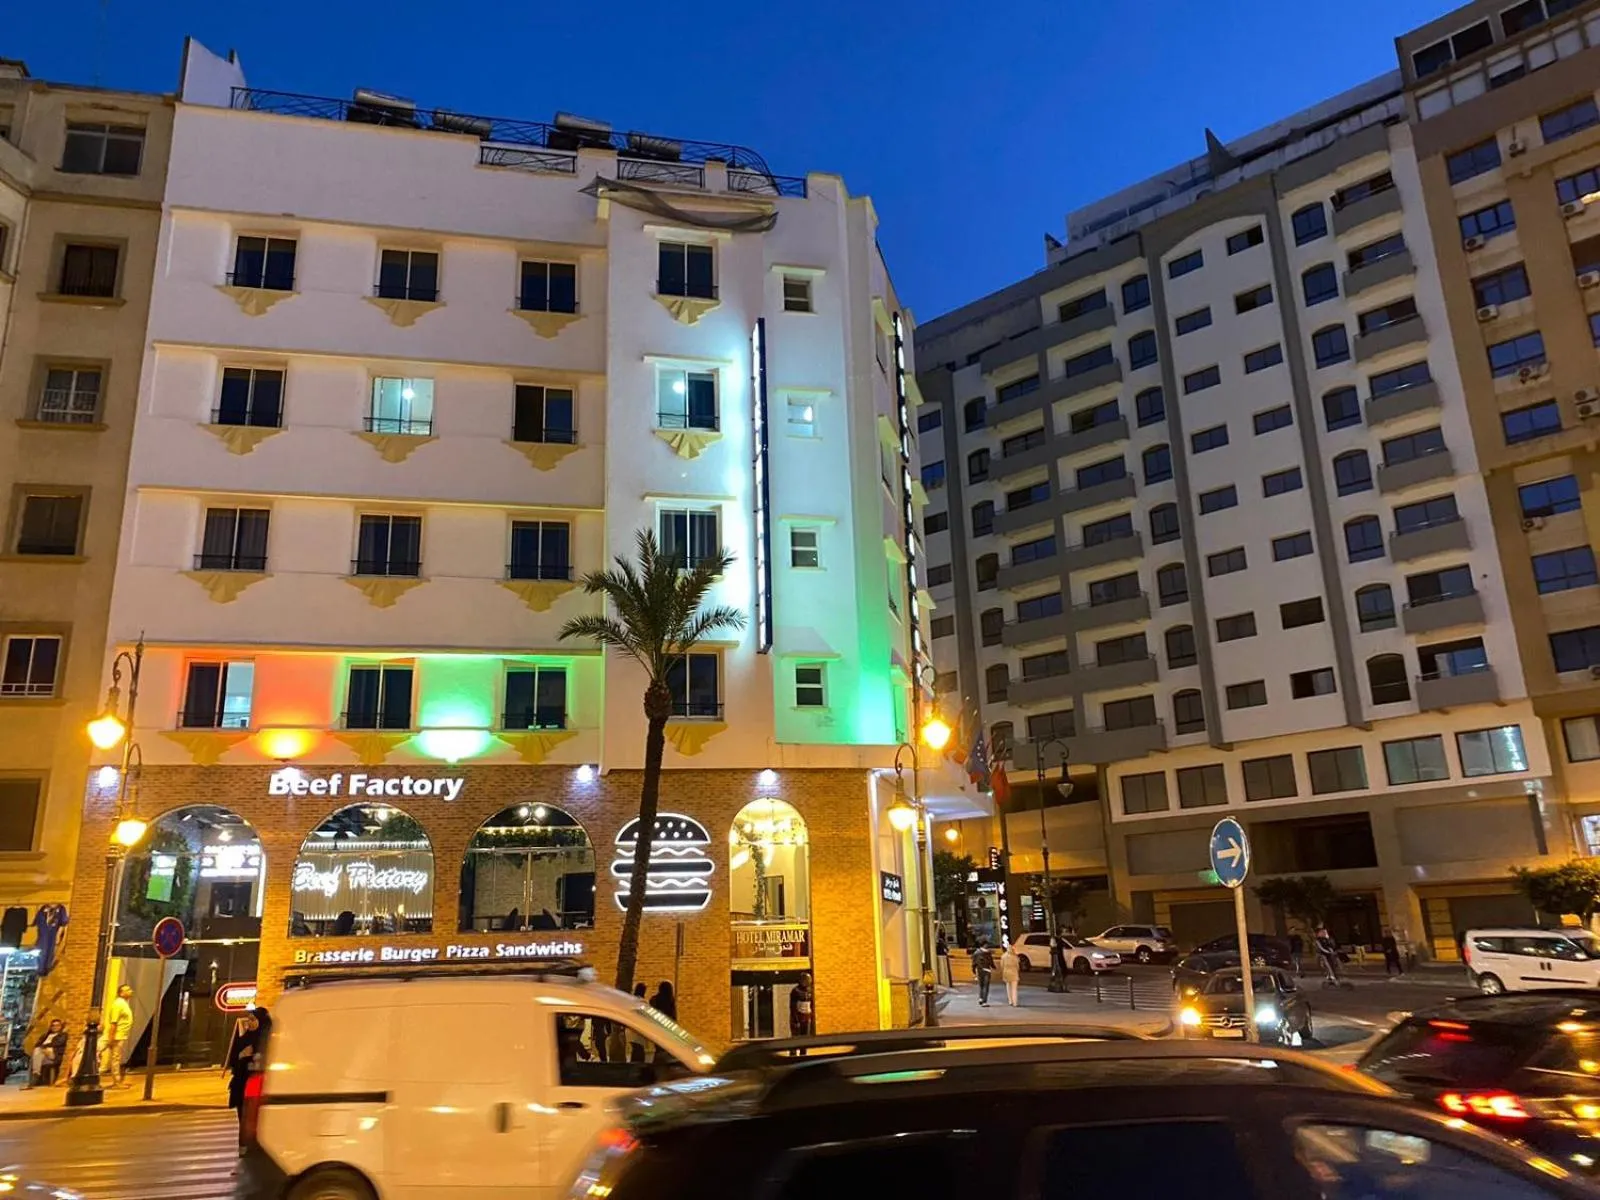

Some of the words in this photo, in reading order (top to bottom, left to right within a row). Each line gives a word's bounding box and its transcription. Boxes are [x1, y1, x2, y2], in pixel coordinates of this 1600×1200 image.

[268, 772, 342, 796] Beef
[349, 774, 464, 801] Factory
[736, 931, 765, 944] HOTEL
[766, 930, 806, 943] MIRAMAR
[294, 948, 375, 963] Brasserie
[380, 946, 439, 961] Burger
[446, 944, 490, 958] Pizza
[495, 941, 583, 957] Sandwichs
